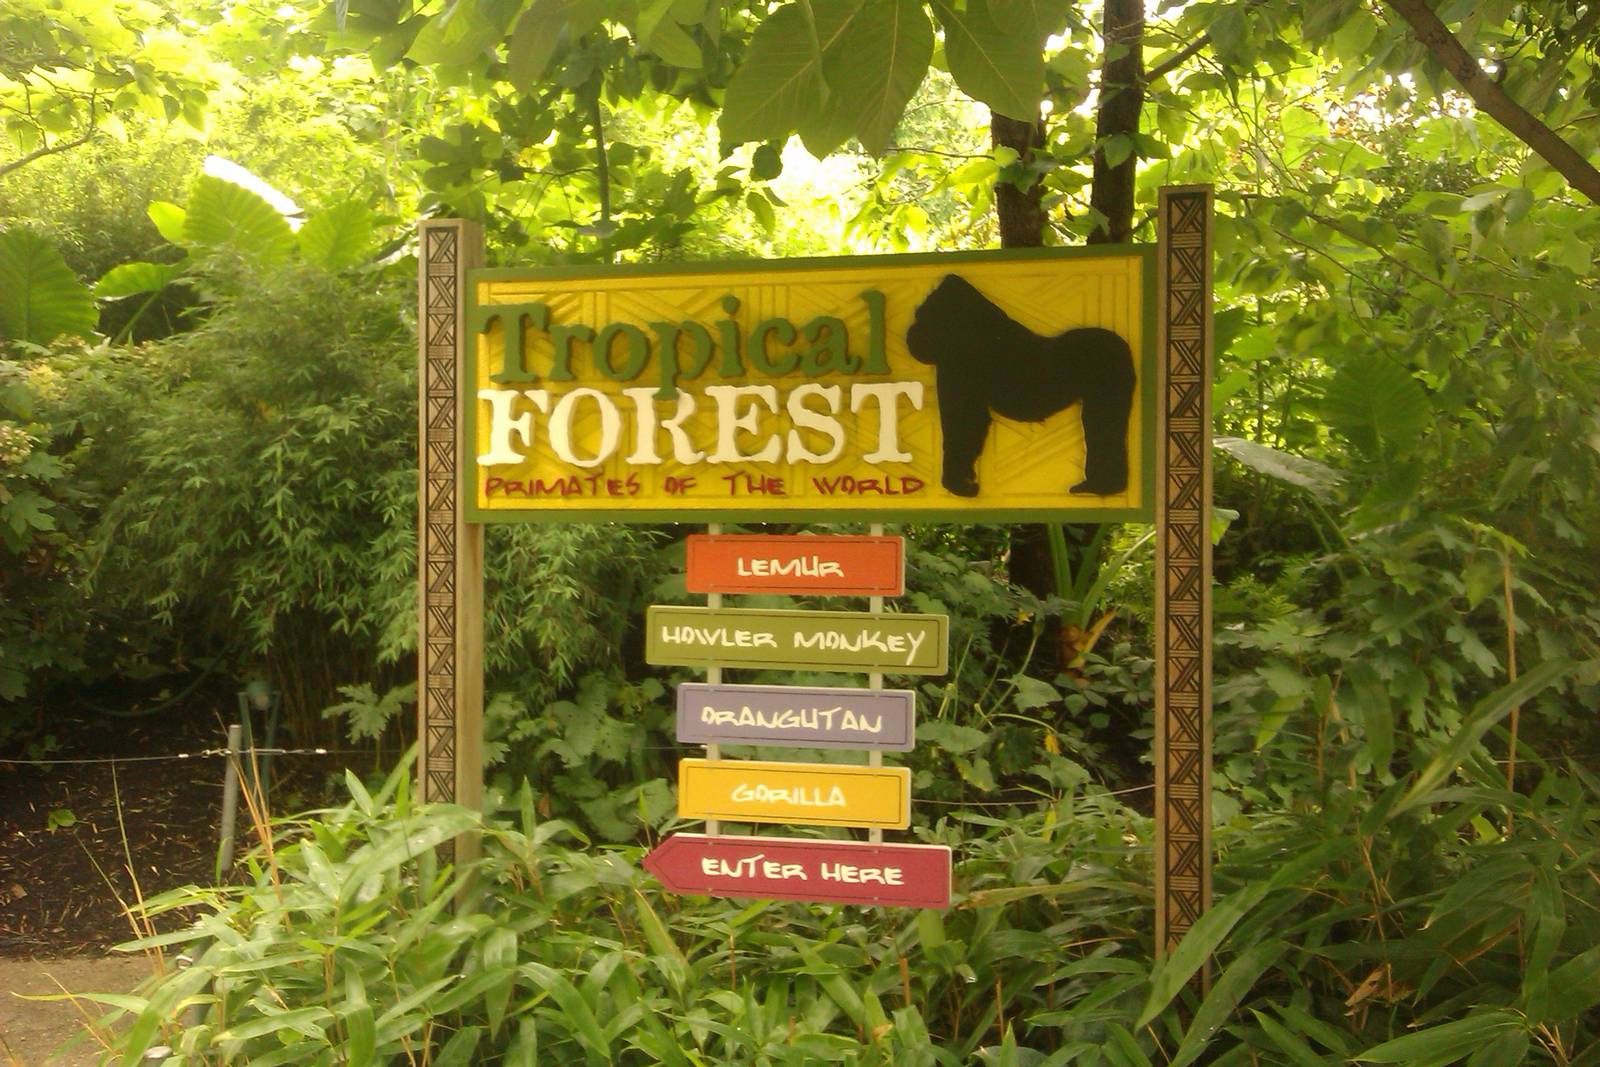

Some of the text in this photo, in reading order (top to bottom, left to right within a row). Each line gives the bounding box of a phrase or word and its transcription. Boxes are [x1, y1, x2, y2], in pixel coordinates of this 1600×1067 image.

[476, 289, 892, 401] Tropical
[477, 381, 924, 468] FOREST
[485, 470, 925, 497] PRIMATES OF THE WORLD
[737, 555, 845, 578] LEMUR
[662, 625, 926, 666] HOWLER MONKEY
[701, 705, 882, 734] ORANGUTAN
[731, 783, 847, 807] GORILLA
[701, 853, 905, 886] ENTER HERE
